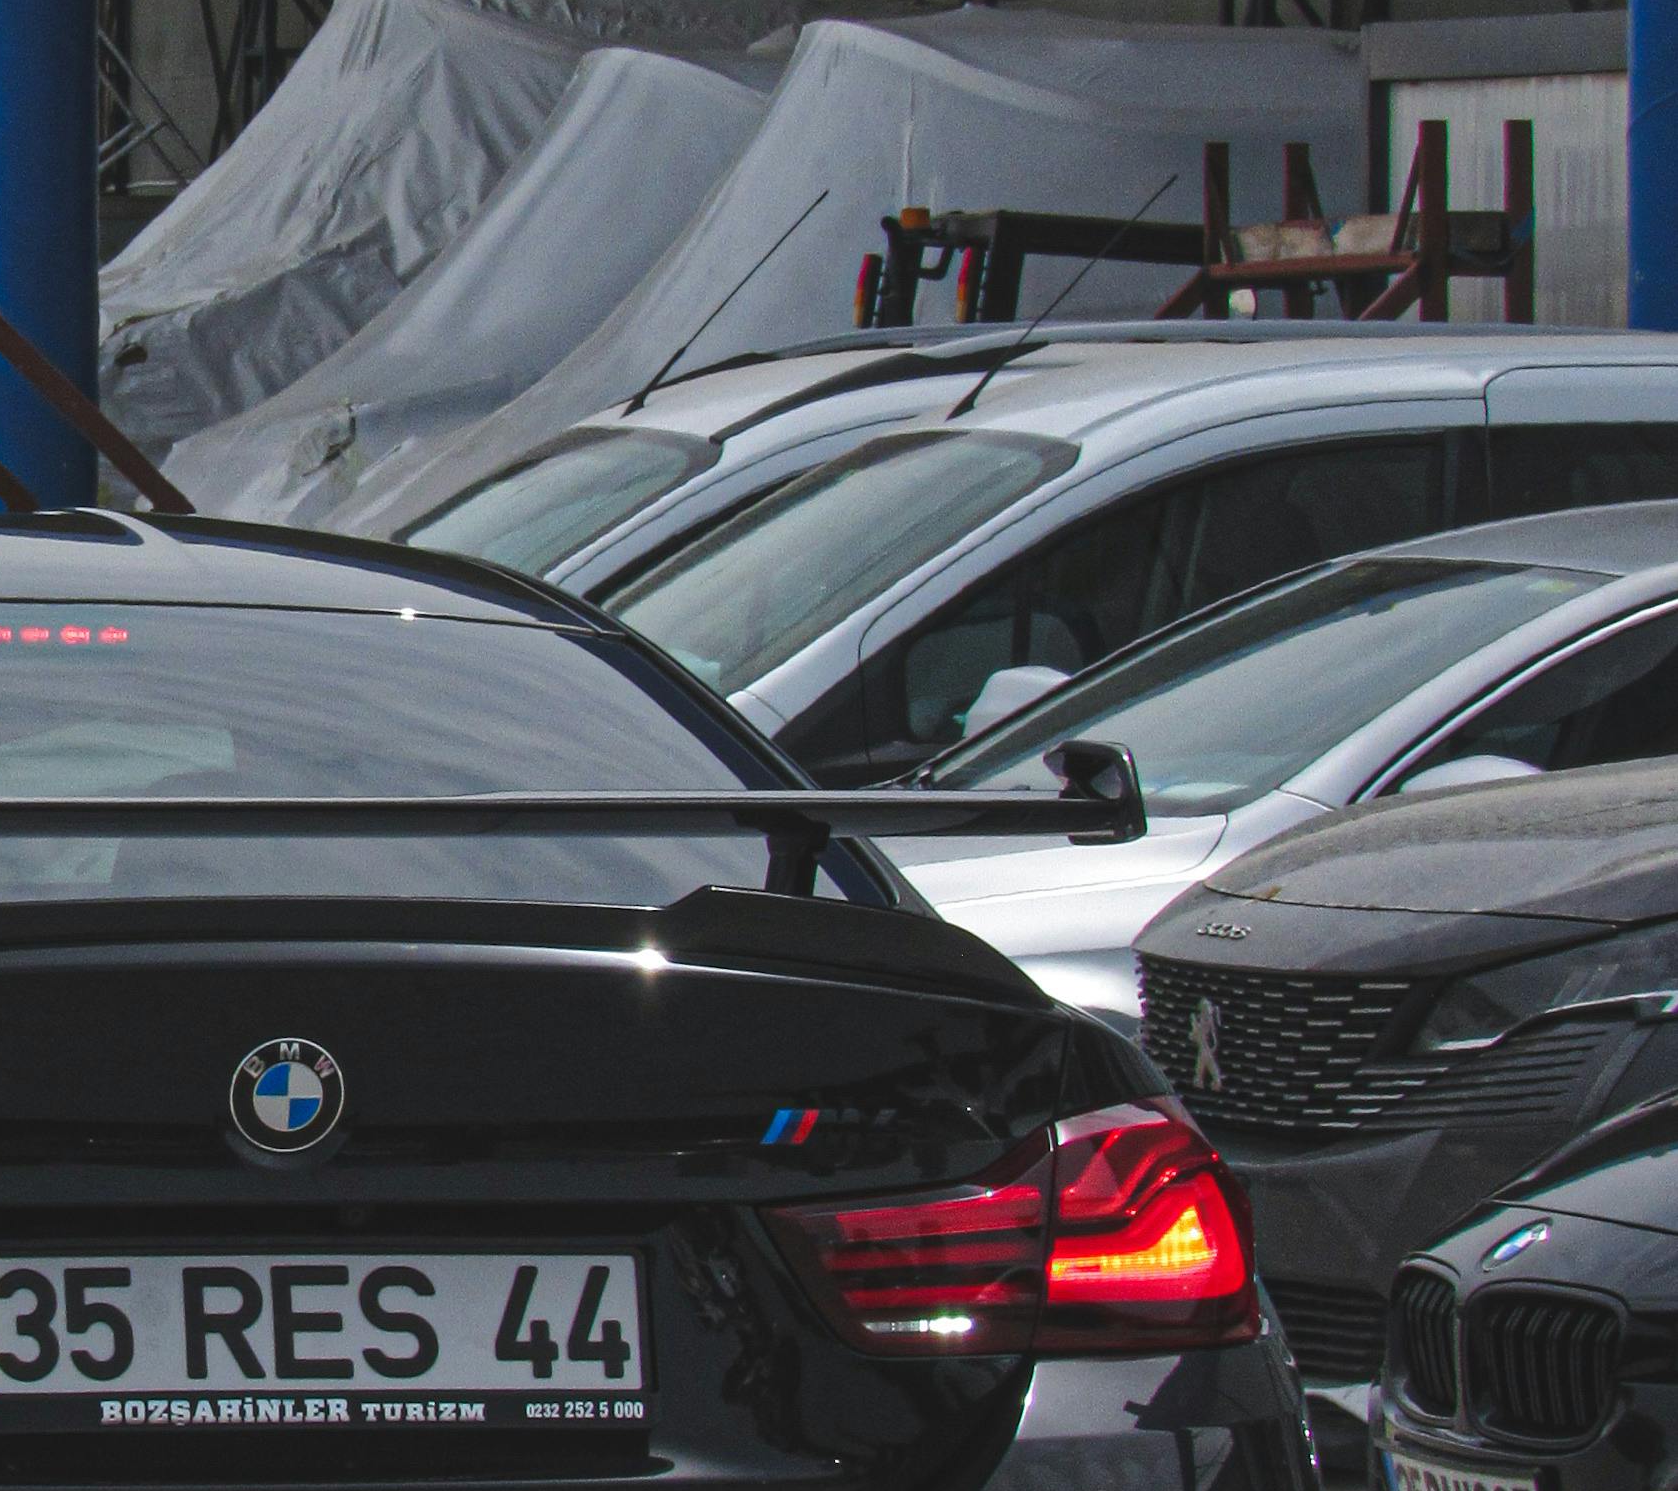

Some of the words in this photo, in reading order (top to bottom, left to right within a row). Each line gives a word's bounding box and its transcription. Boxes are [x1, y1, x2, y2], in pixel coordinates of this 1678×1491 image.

[243, 1042, 335, 1079] BMW
[181, 1265, 440, 1380] RES
[494, 1264, 631, 1379] 44
[526, 1403, 560, 1419] 0232
[564, 1401, 595, 1419] 252
[599, 1401, 610, 1419] 5
[614, 1401, 644, 1419] 000
